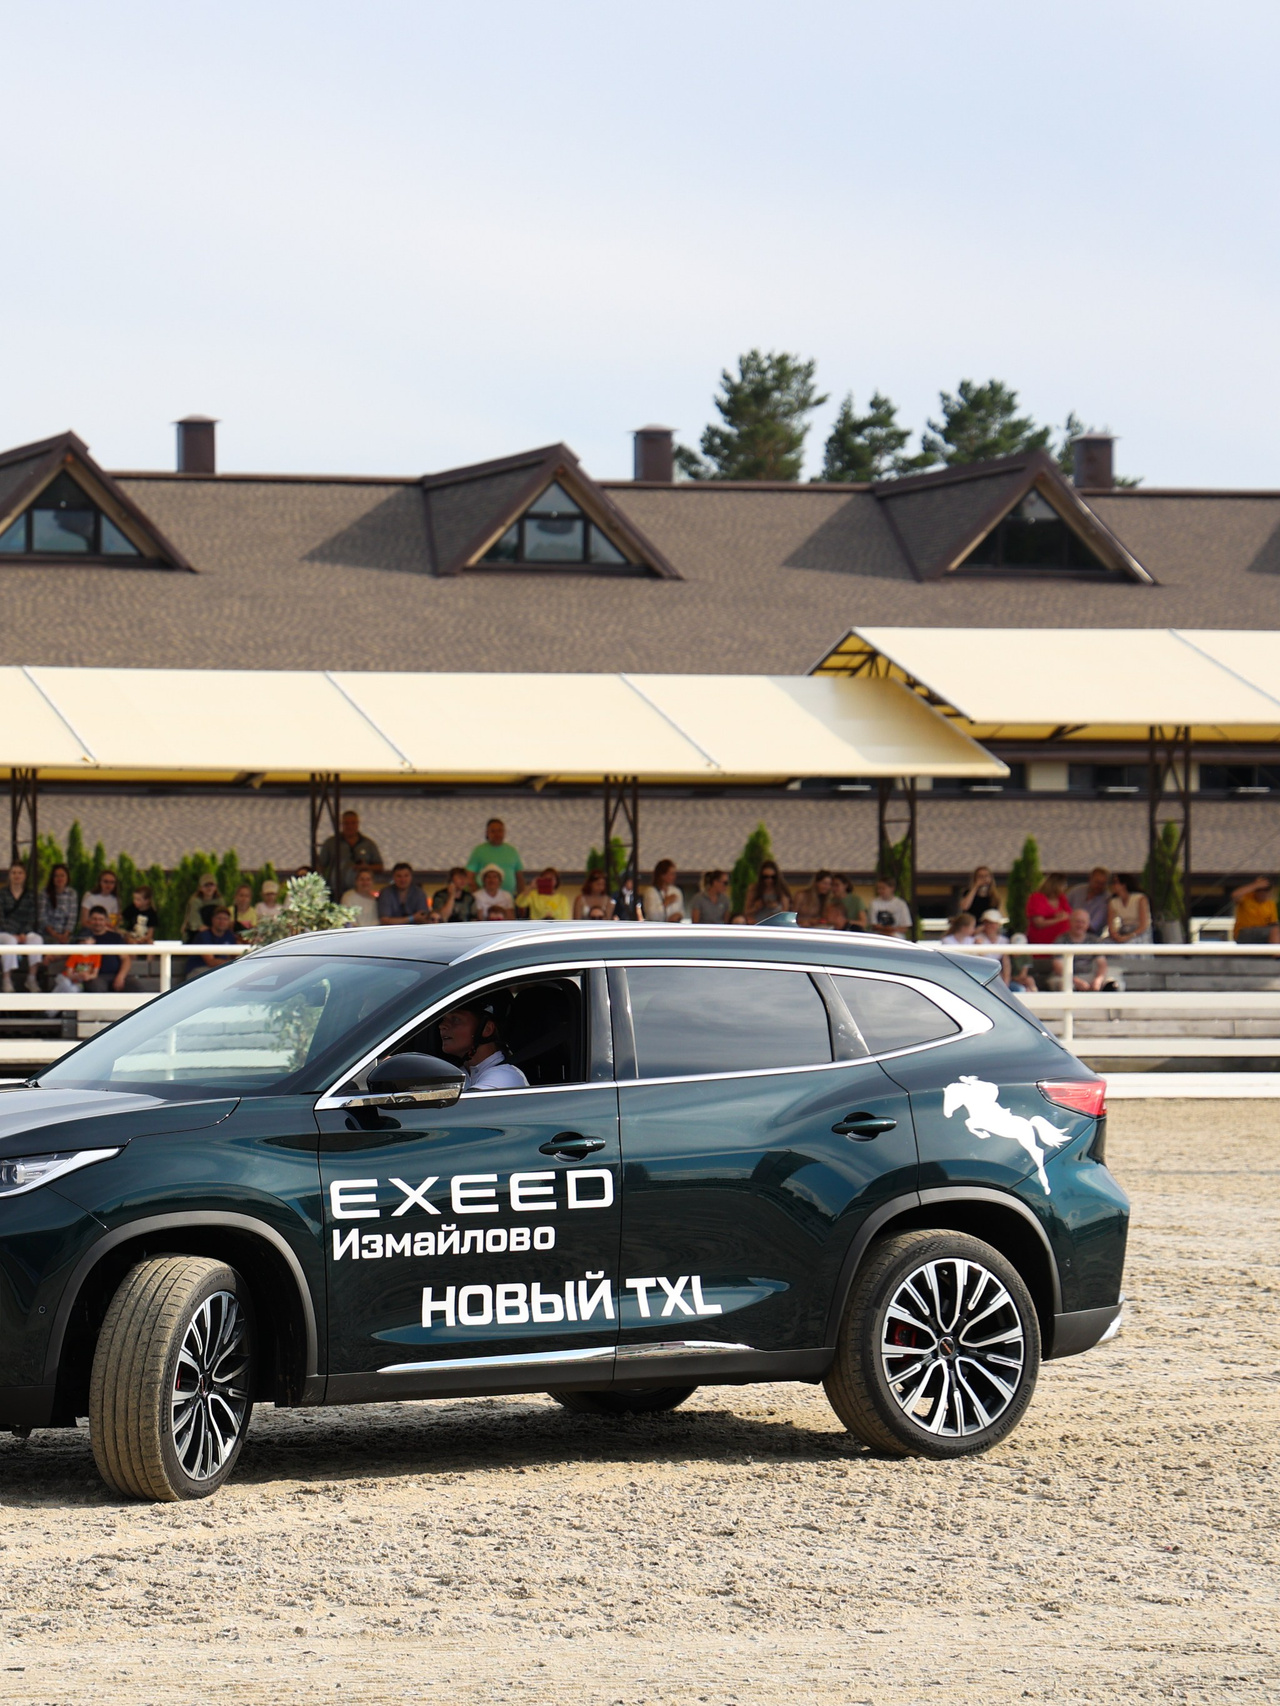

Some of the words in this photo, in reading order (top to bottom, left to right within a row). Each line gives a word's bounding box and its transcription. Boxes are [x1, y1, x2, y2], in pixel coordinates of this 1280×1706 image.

[330, 1169, 614, 1219] EXEED
[332, 1224, 556, 1260] Измайлово
[422, 1271, 616, 1328] НОВЫЙ
[626, 1275, 723, 1317] TXL
